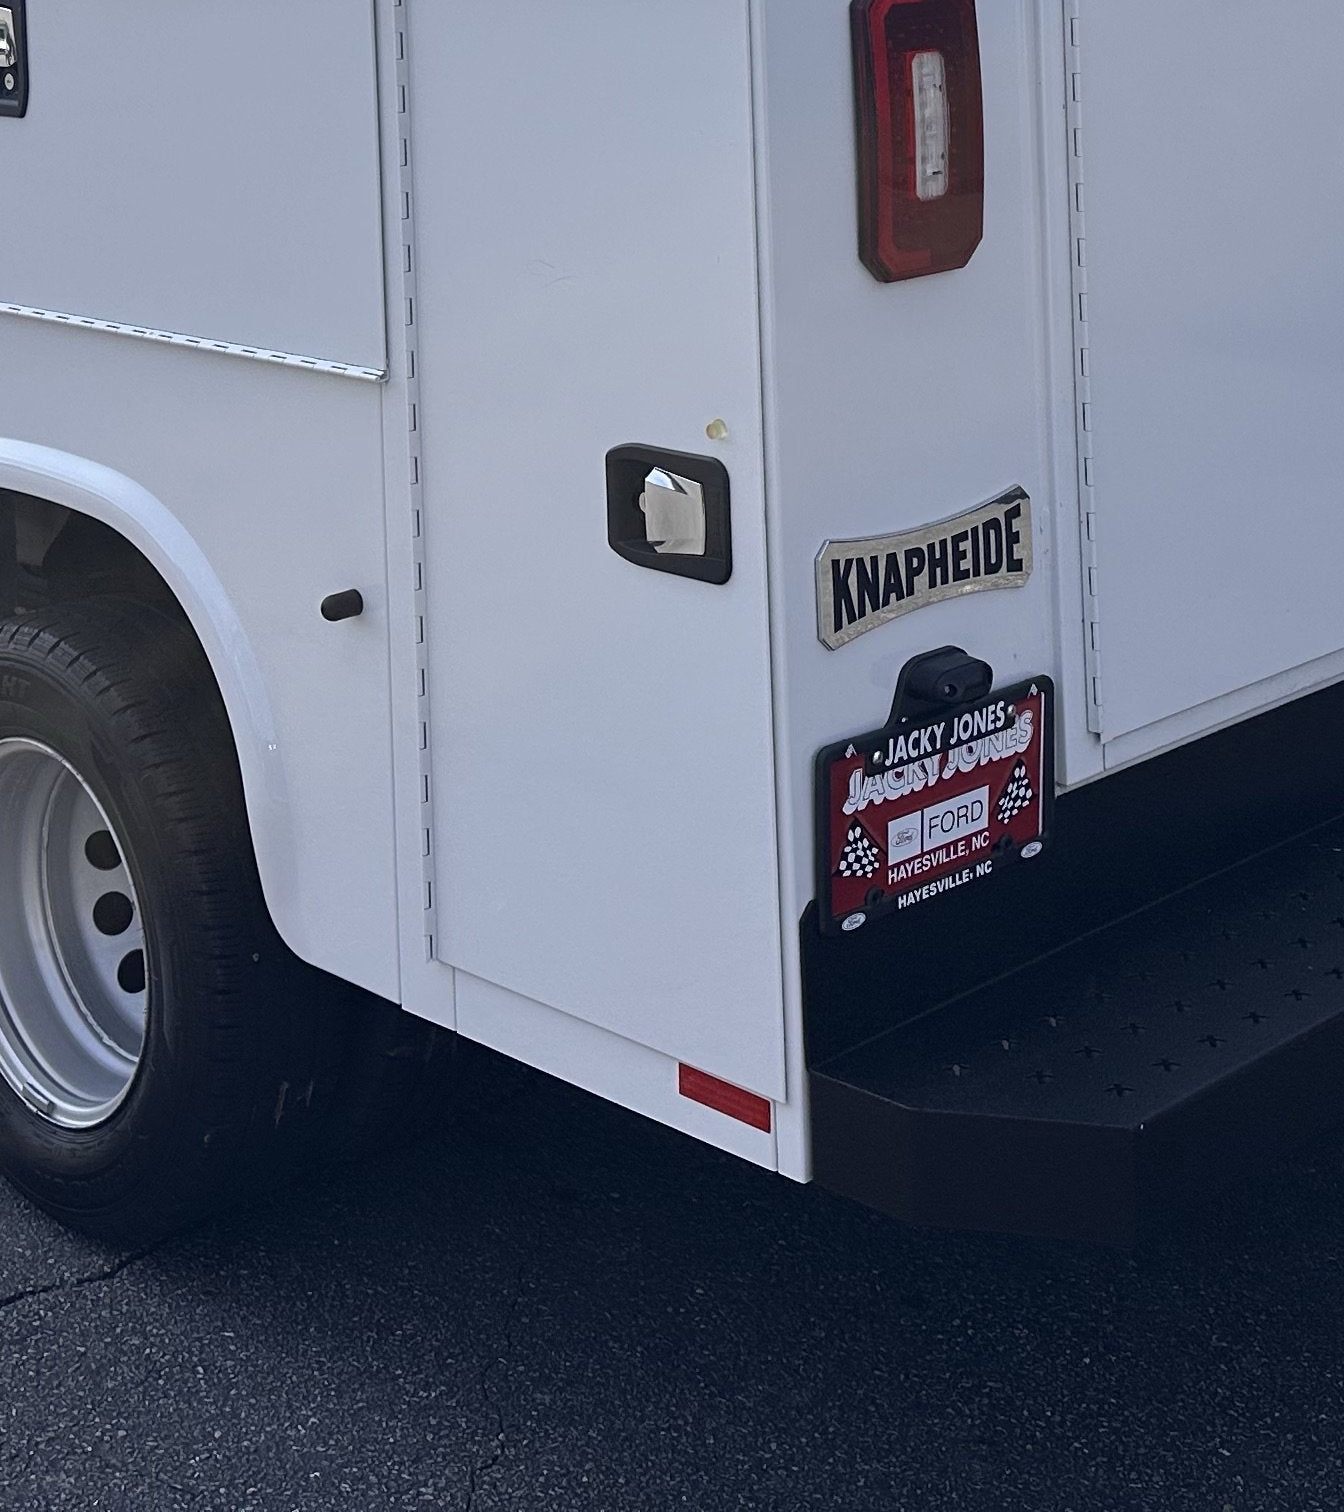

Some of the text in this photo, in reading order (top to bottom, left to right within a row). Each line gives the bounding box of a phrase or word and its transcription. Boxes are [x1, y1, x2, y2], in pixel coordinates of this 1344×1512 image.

[830, 501, 1024, 635] KNAPHEIDE
[884, 700, 1006, 767] JACKY JONES
[927, 799, 984, 839] FORD
[887, 831, 990, 886] HAYESVILLE, NC
[975, 859, 993, 877] NC
